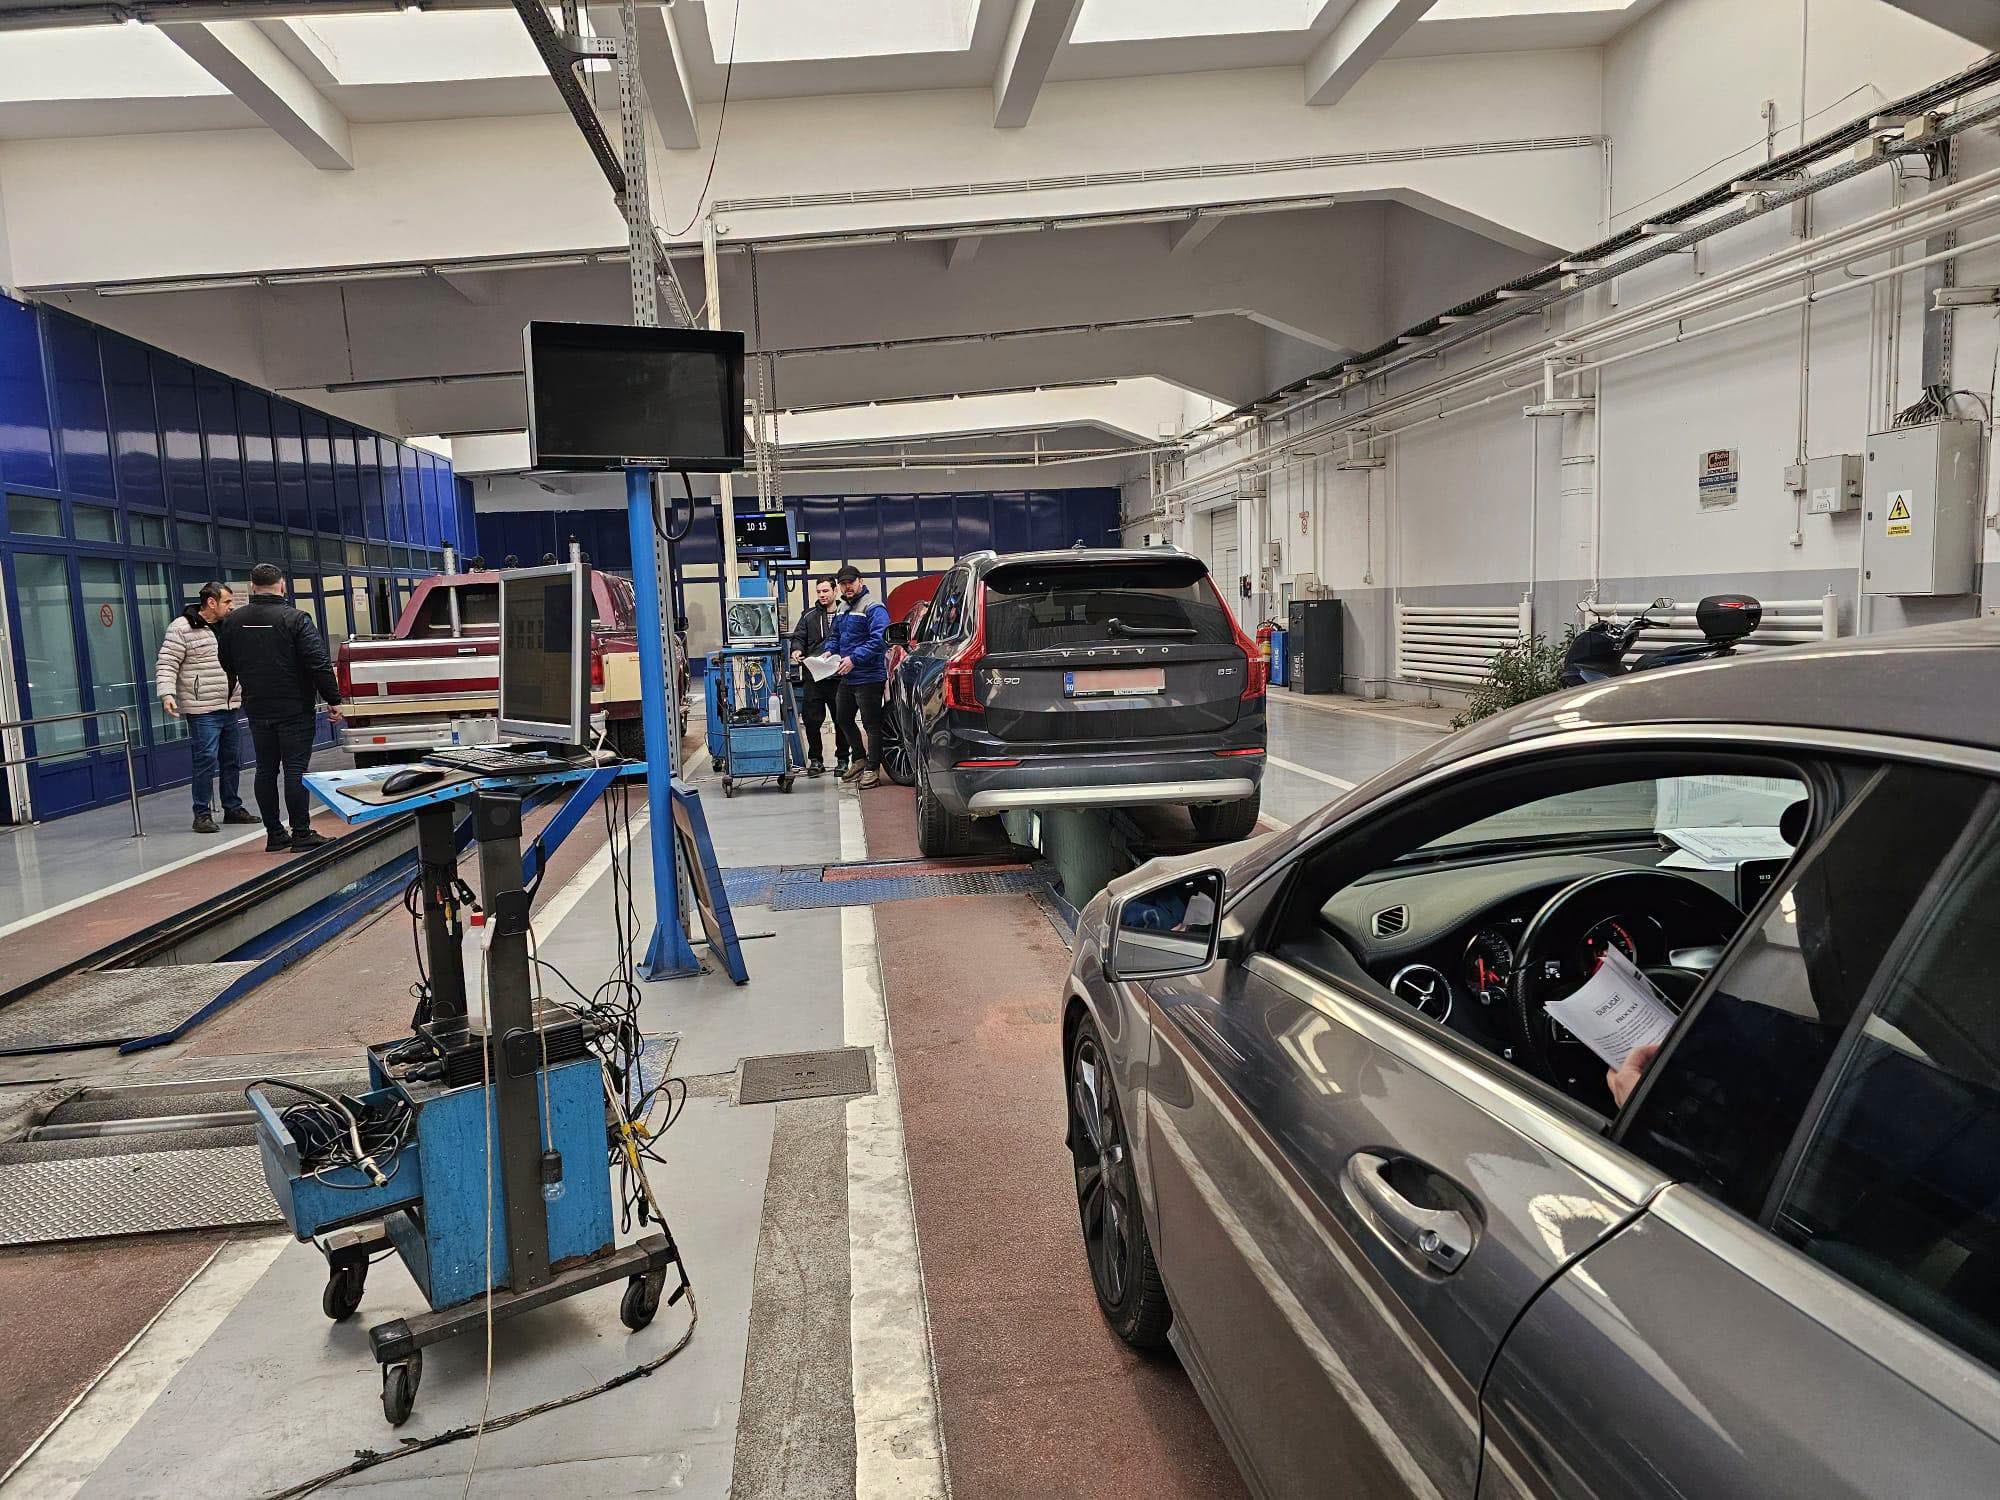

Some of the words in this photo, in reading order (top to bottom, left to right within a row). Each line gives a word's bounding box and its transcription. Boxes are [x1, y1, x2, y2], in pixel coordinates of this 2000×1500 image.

[746, 522, 755, 531] 10
[758, 522, 767, 531] 15
[1061, 647, 1169, 658] VOLVO
[985, 677, 1021, 685] XC90
